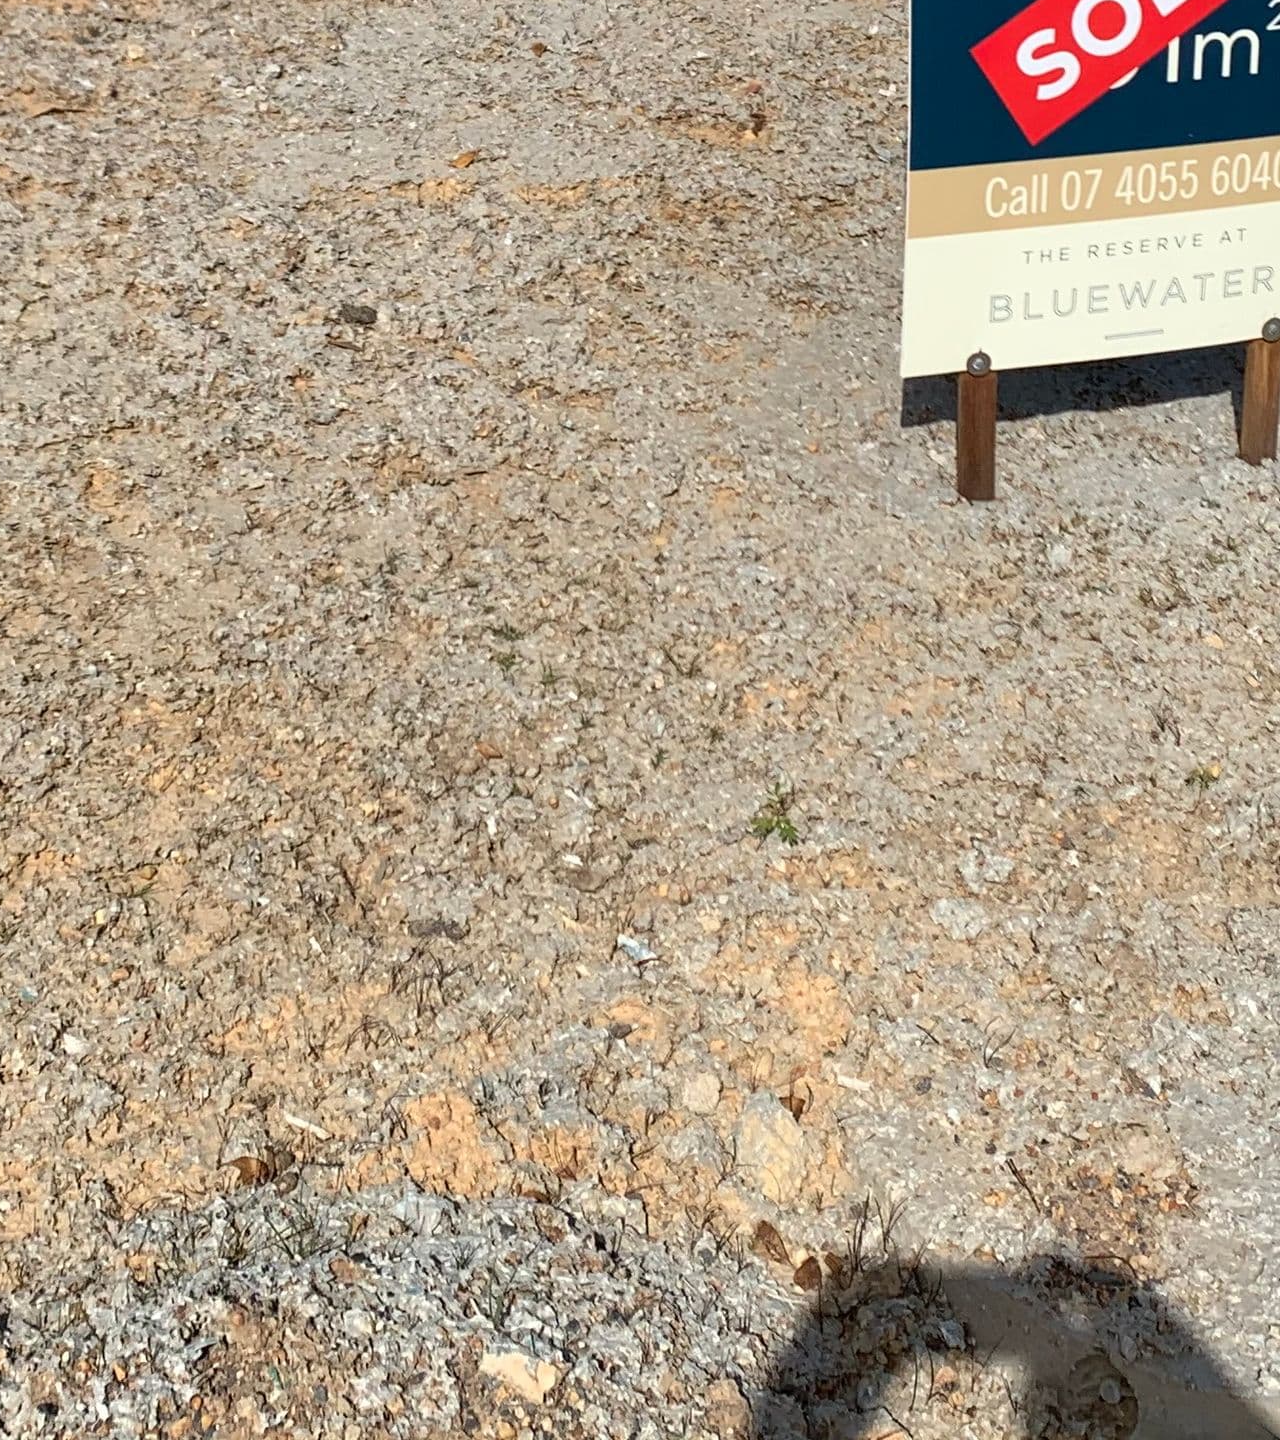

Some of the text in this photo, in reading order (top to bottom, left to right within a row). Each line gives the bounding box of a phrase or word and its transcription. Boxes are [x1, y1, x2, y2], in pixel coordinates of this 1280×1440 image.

[986, 174, 1048, 219] Call
[1060, 168, 1103, 211] 07
[1114, 159, 1197, 206] 4055
[1023, 228, 1248, 265] THE RESERVE AT
[989, 265, 1276, 324] BLUEWATER
